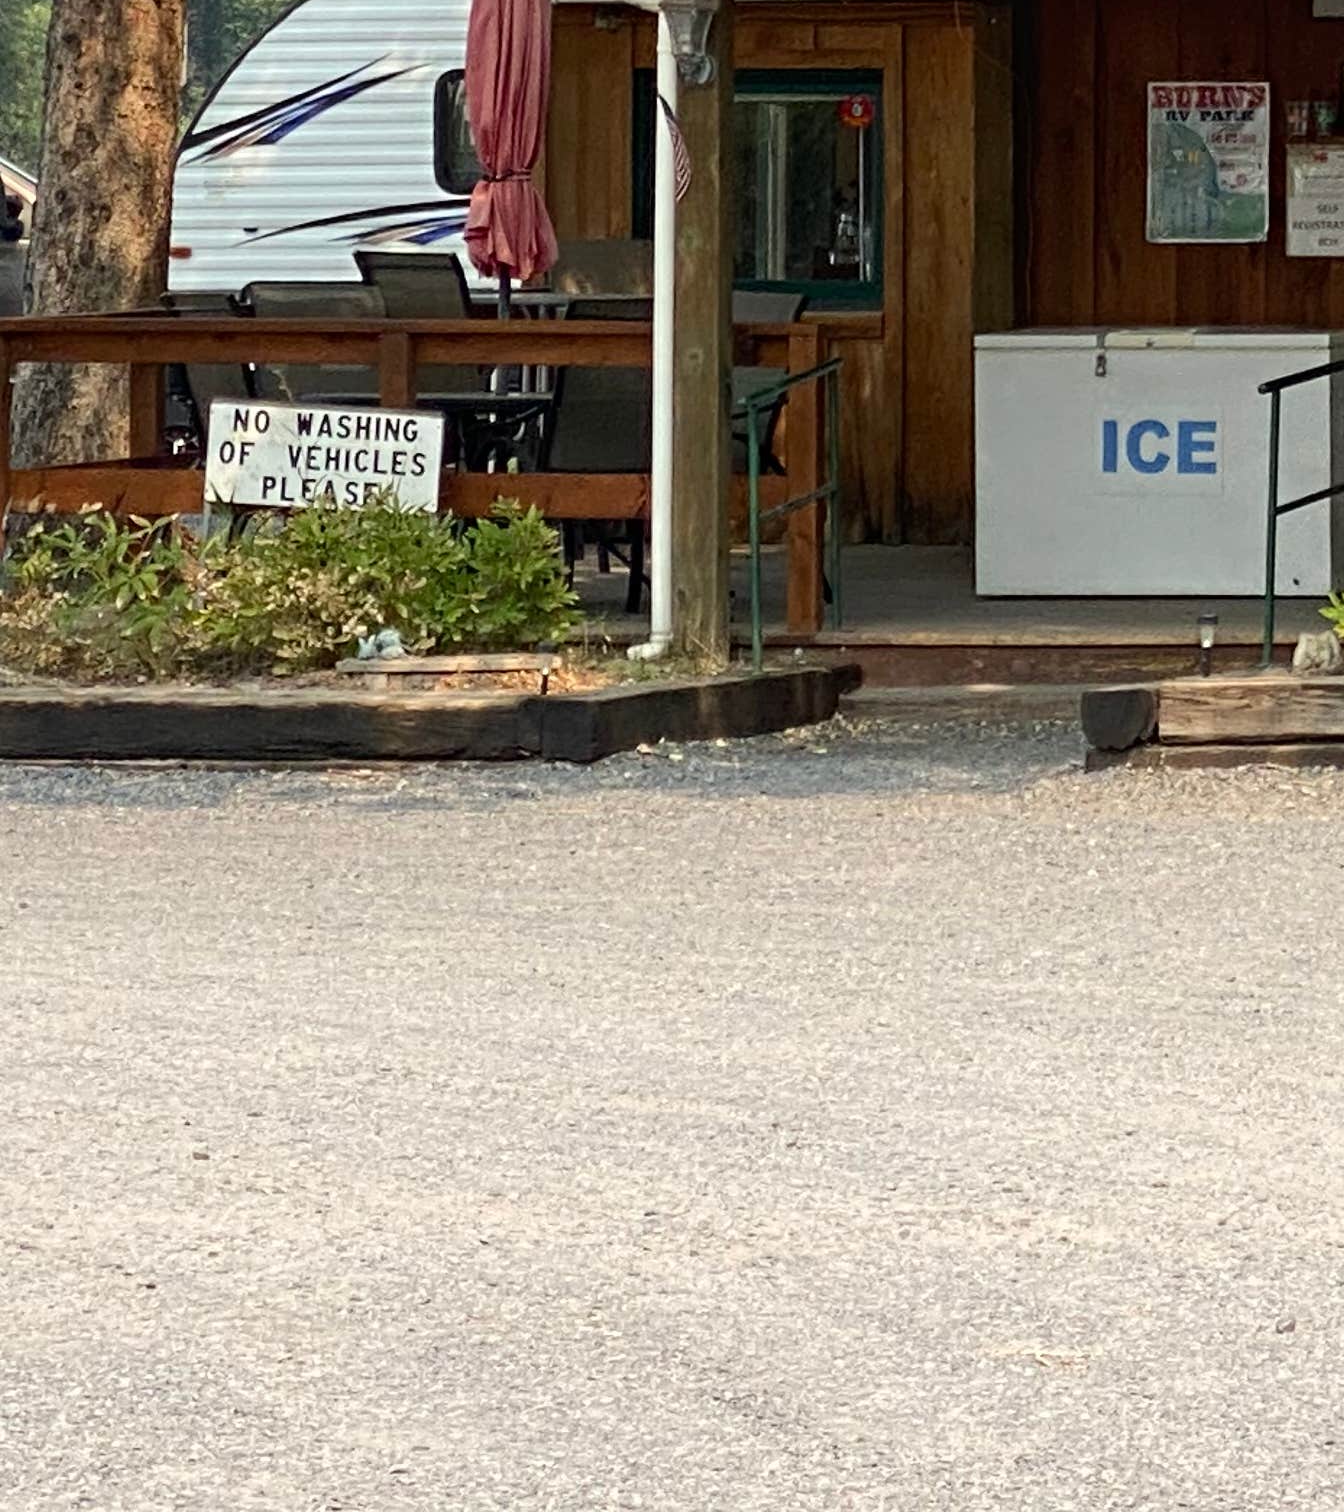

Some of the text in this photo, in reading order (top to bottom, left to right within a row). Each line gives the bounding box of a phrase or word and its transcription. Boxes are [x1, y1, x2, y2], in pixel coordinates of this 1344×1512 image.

[1165, 110, 1254, 121] RV PARK
[232, 408, 419, 442] NO WASHING
[219, 440, 427, 477] OF VEHICLES
[1102, 419, 1217, 474] ICE
